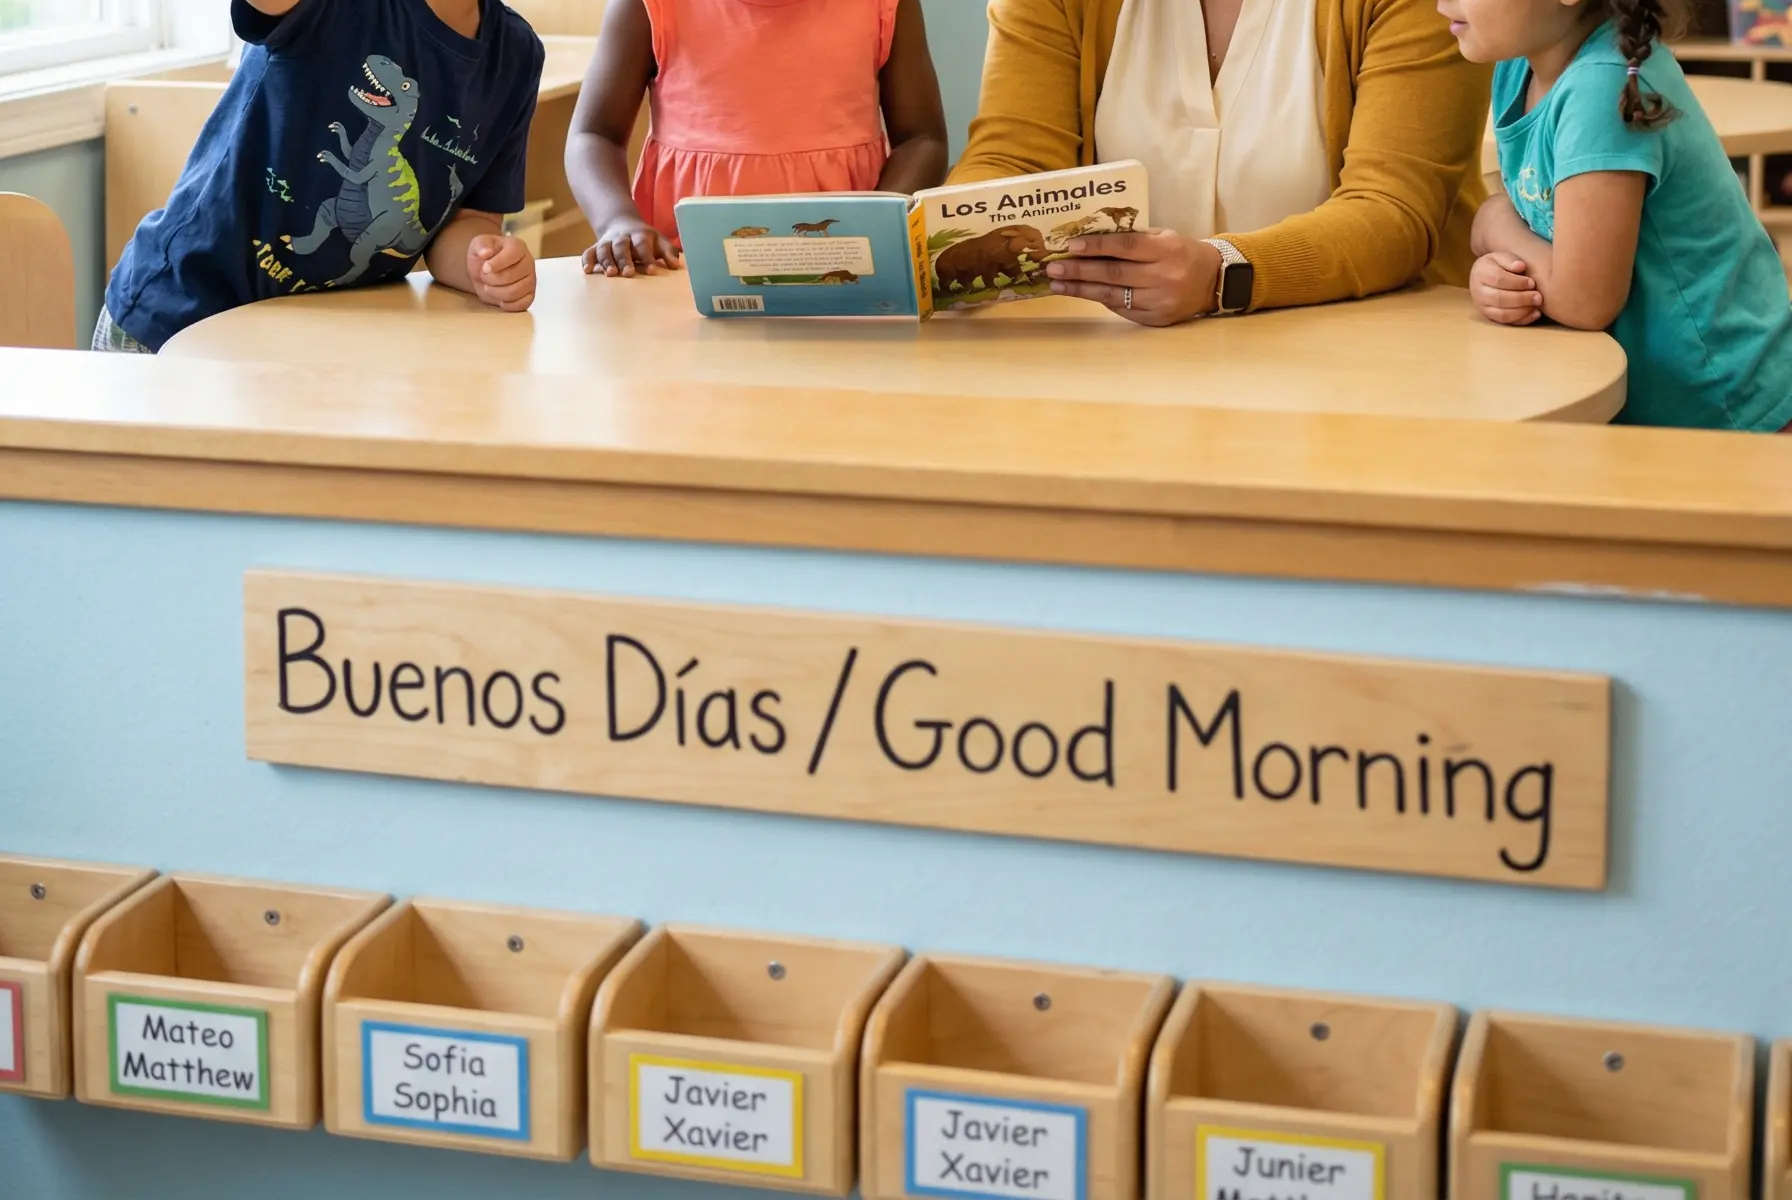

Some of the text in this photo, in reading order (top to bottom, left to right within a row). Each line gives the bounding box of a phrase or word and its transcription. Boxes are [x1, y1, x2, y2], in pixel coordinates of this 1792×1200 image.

[941, 179, 1127, 219] Los Animales
[989, 202, 1081, 223] The Animals
[277, 607, 566, 736] Buenos
[1167, 683, 1555, 873] Morning
[142, 1013, 234, 1049] Mateo
[123, 1050, 254, 1092] Matthew
[403, 1043, 486, 1077] Sofia
[393, 1082, 498, 1121] Sophia
[664, 1075, 767, 1112] Javier
[662, 1115, 769, 1153] Xavier
[940, 1109, 1048, 1147] Javier
[939, 1151, 1050, 1190] Xavier
[1232, 1146, 1346, 1186] Junier
